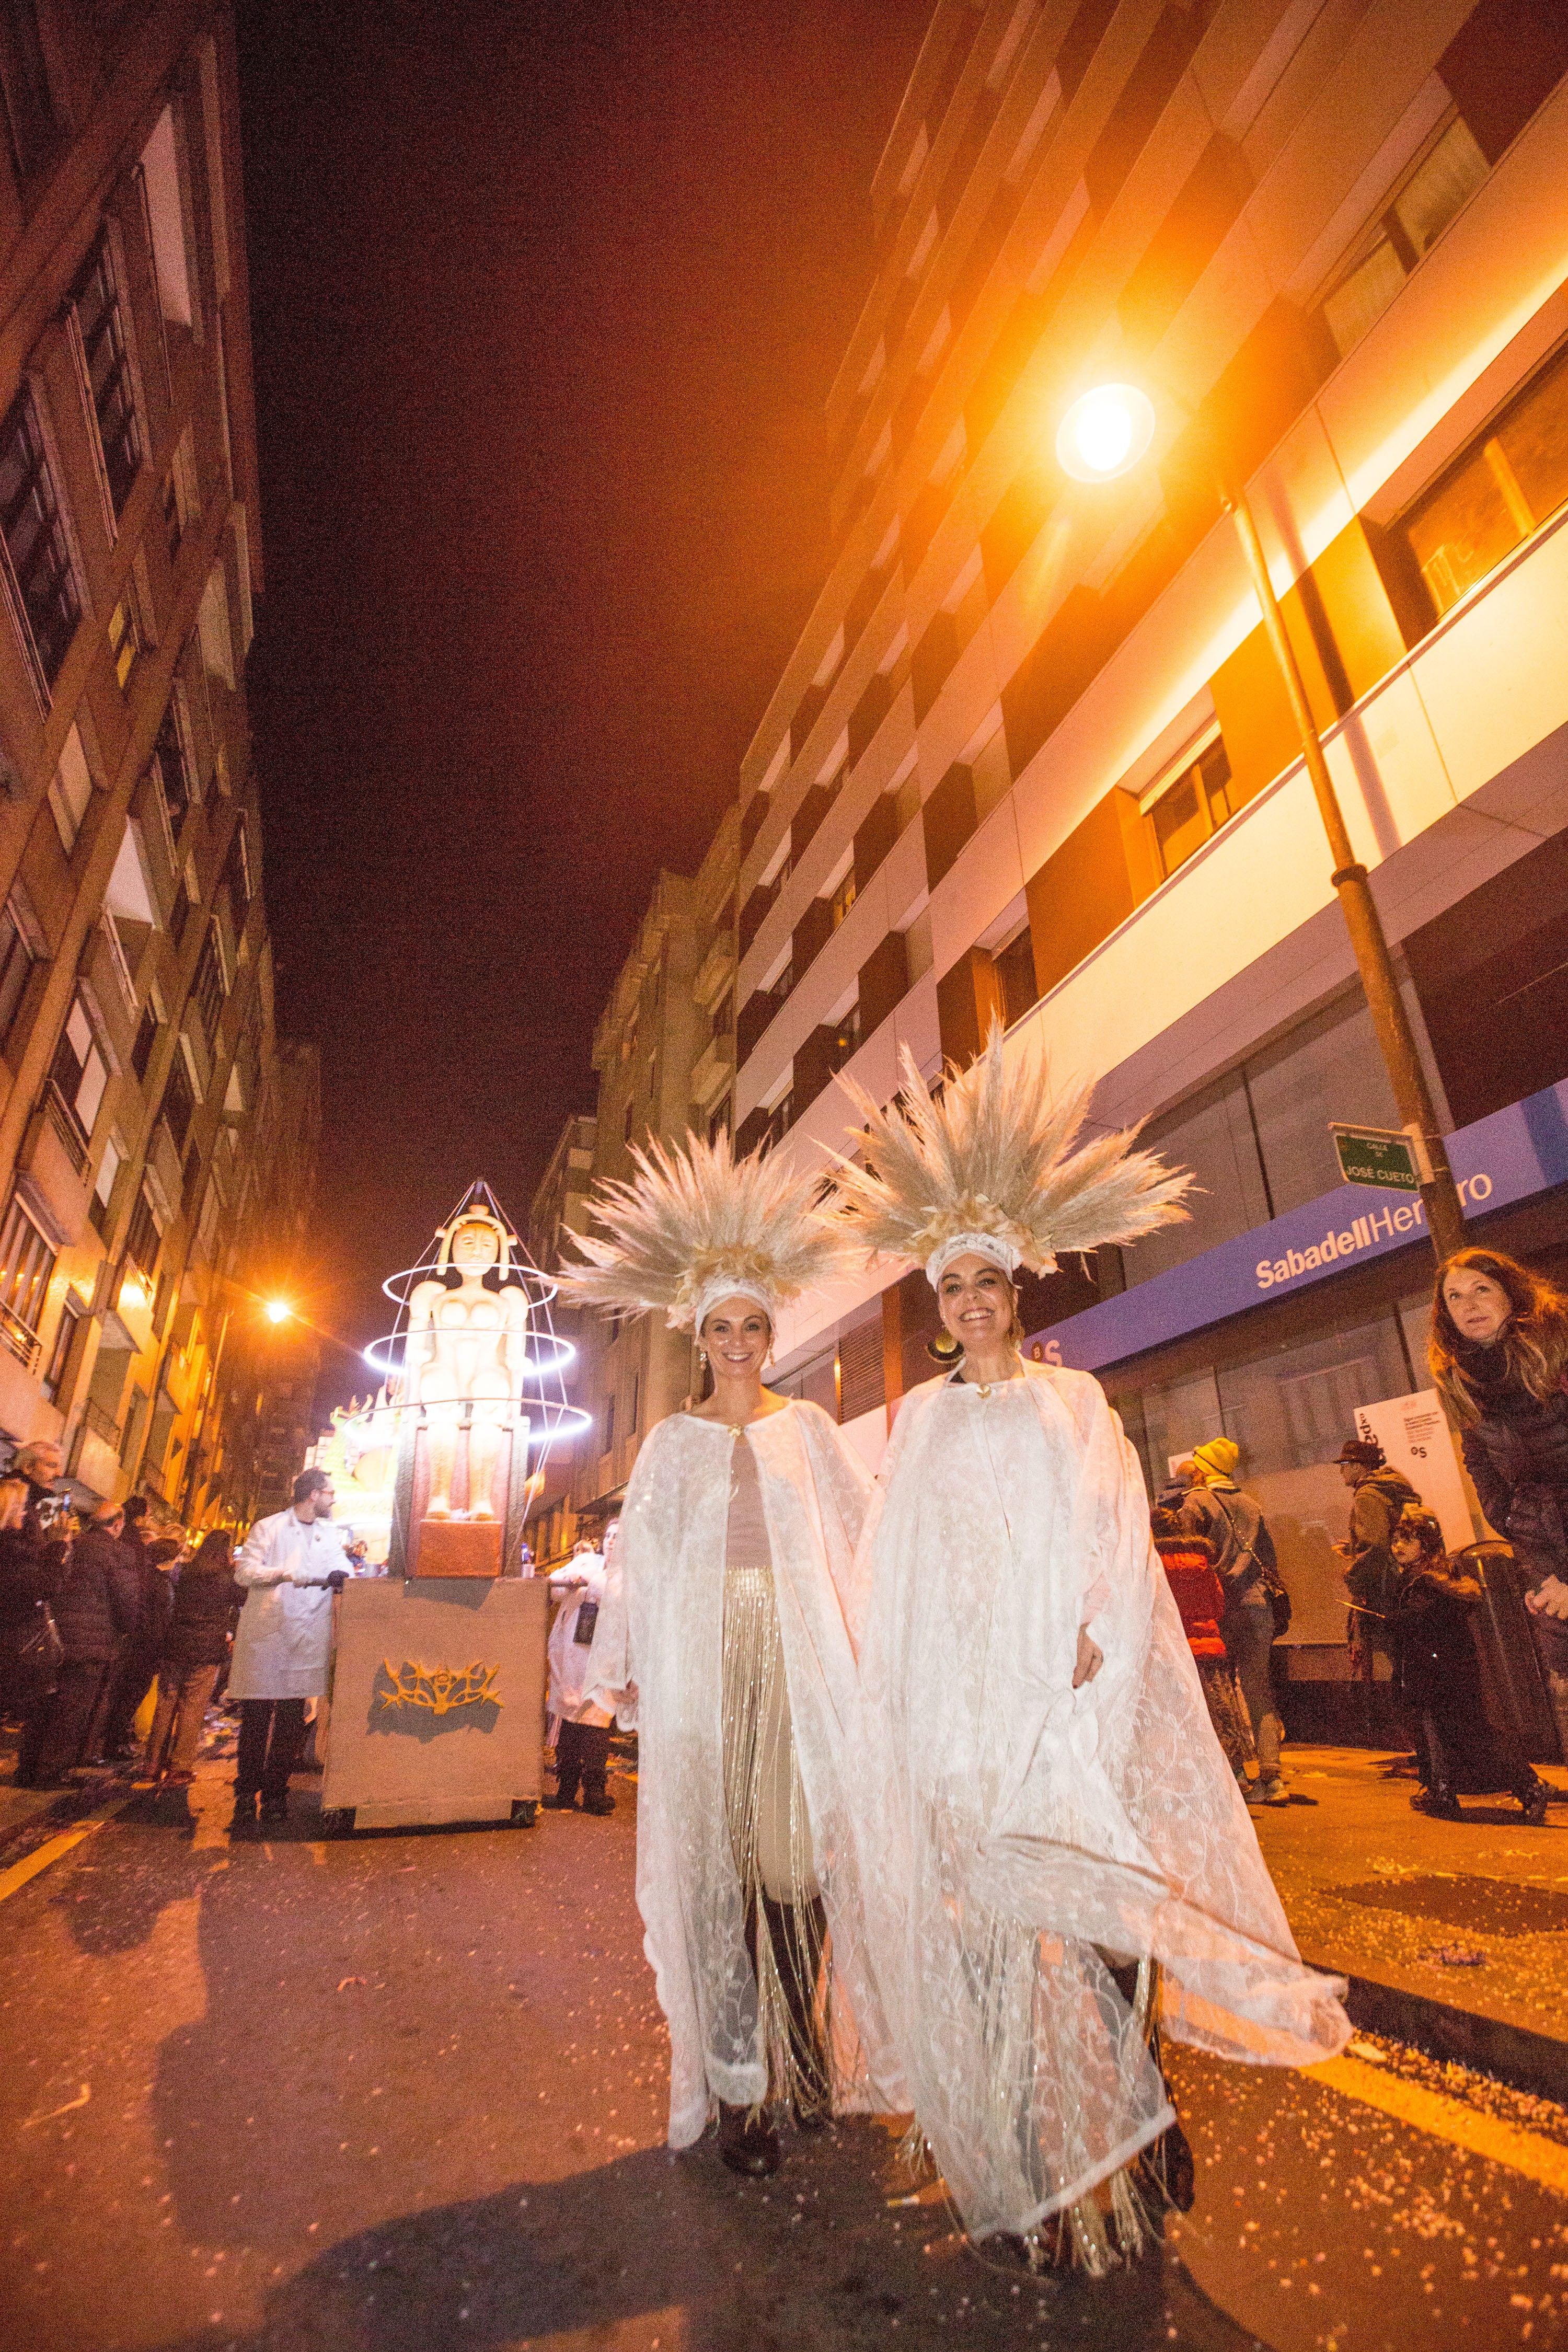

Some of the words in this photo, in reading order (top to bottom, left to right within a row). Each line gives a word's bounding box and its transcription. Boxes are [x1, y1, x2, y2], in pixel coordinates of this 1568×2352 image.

[1366, 1143, 1388, 1151] CALLE
[1347, 1166, 1375, 1179] JOSÉ
[1377, 1170, 1414, 1184] CUETO
[1256, 1173, 1492, 1289] SabadellHerro
